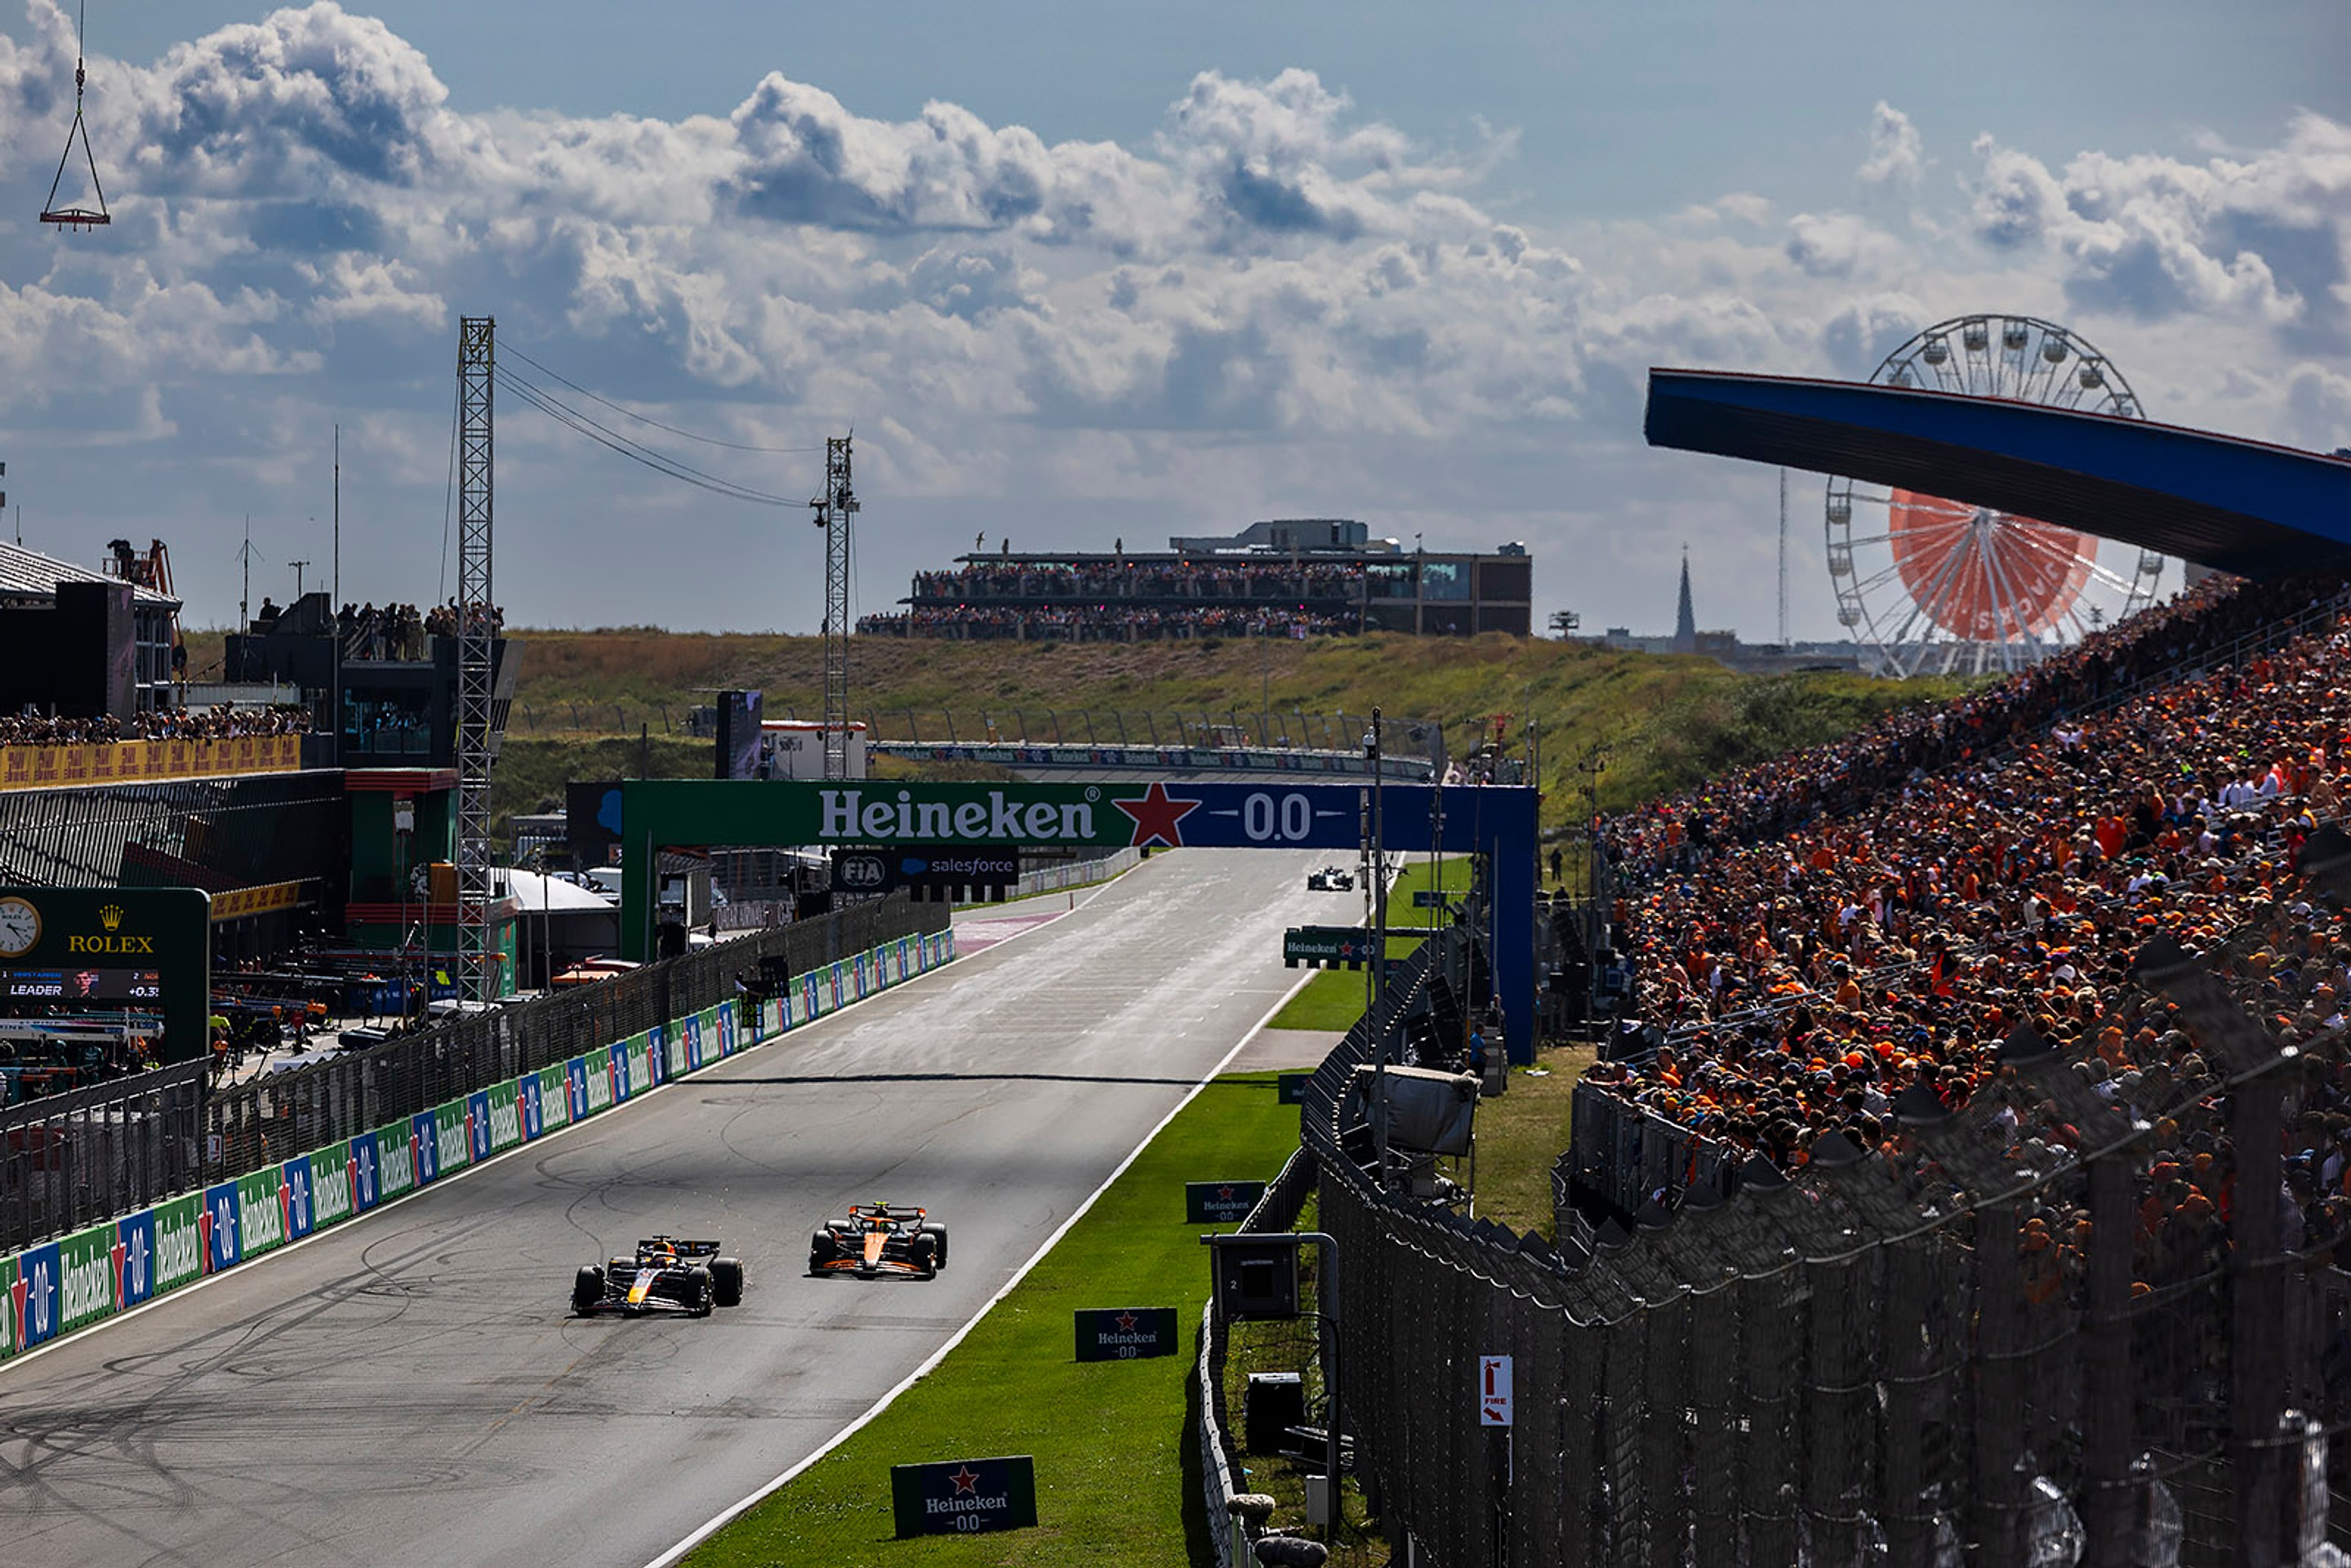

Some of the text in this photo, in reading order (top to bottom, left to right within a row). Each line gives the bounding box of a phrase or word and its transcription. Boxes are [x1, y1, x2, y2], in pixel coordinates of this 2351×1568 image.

[819, 791, 1096, 840] Heineken
[1244, 792, 1311, 841] 0.0
[931, 858, 1013, 876] salesforce
[69, 936, 154, 954] ROLEX
[1287, 942, 1337, 954] Heineken
[11, 985, 63, 996] LEADER
[1204, 1200, 1249, 1210] Heineken
[155, 1212, 198, 1285] Heineken
[60, 1244, 110, 1324] Heineken
[1231, 1280, 1237, 1290] 2
[1098, 1332, 1156, 1344] Heineken
[925, 1495, 1008, 1514] Heineken
